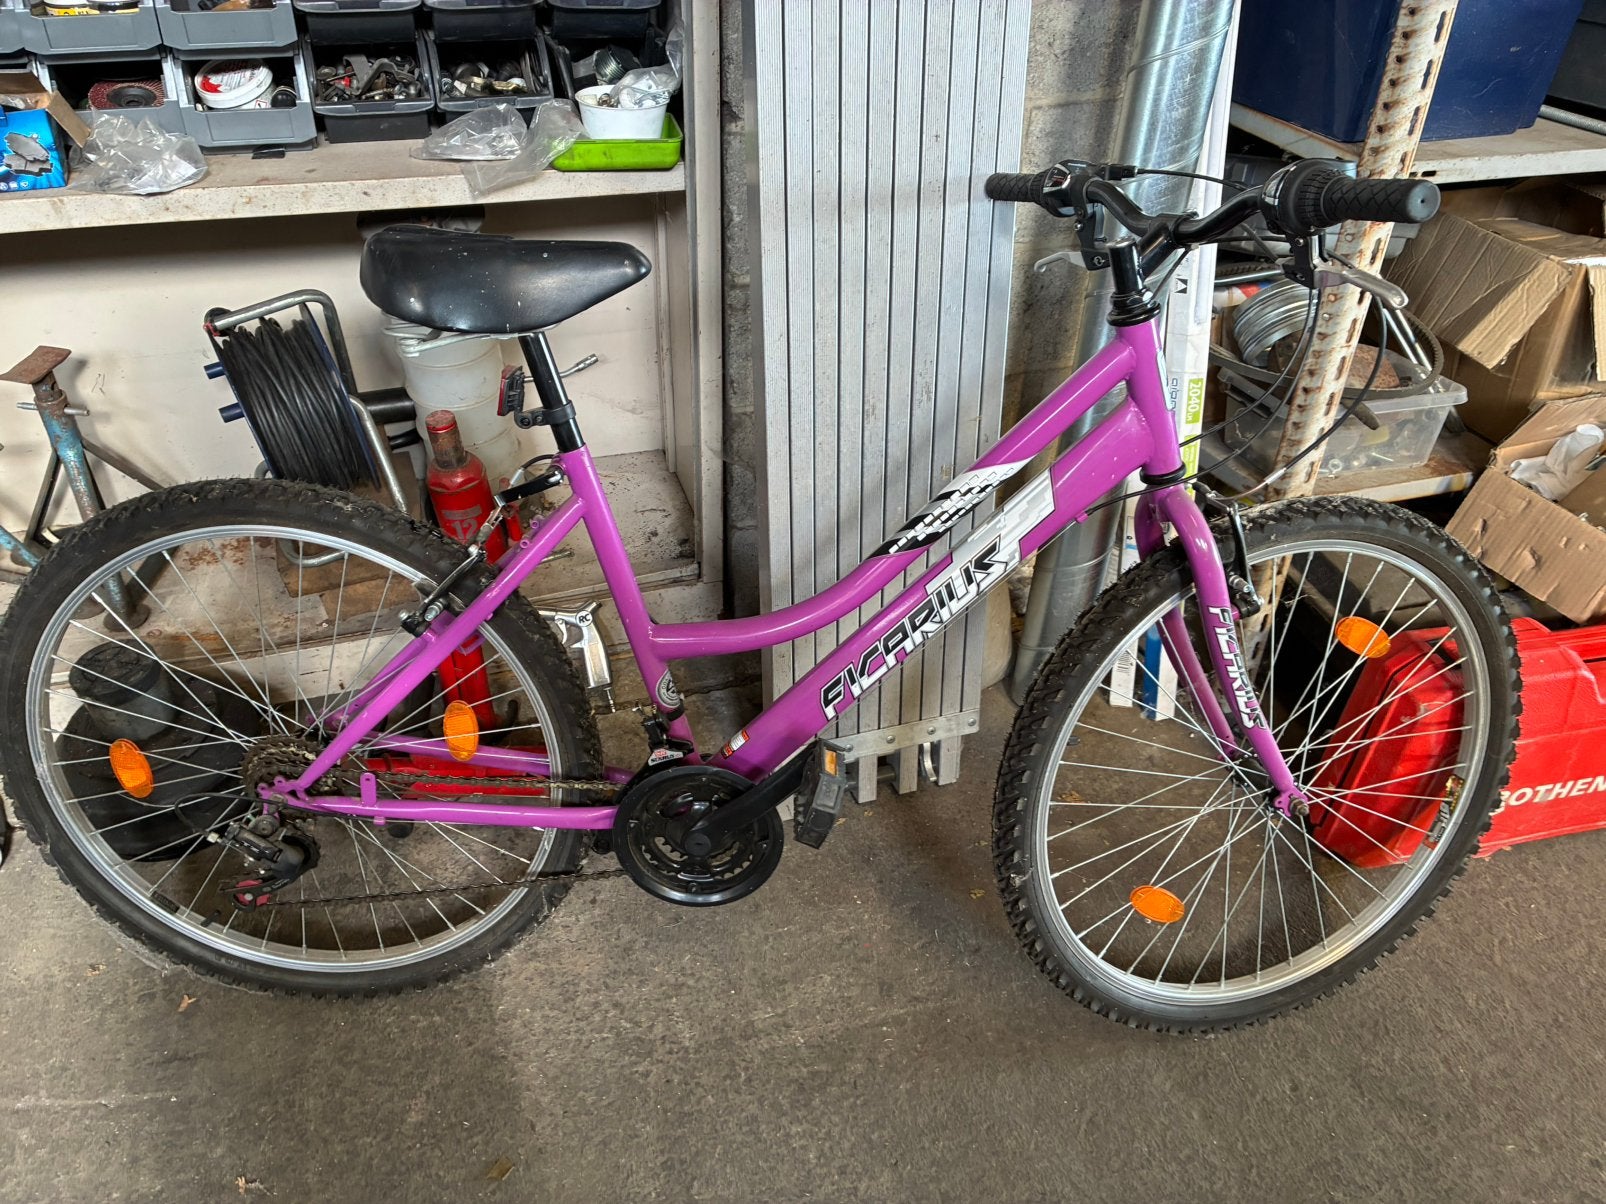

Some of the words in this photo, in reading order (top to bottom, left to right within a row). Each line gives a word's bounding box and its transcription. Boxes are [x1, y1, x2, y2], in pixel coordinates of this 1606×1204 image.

[1188, 381, 1202, 412] 2040
[452, 519, 478, 540] 12
[578, 613, 591, 624] RC
[820, 534, 1008, 721] FICARIUS
[1208, 606, 1267, 730] FICARIUS
